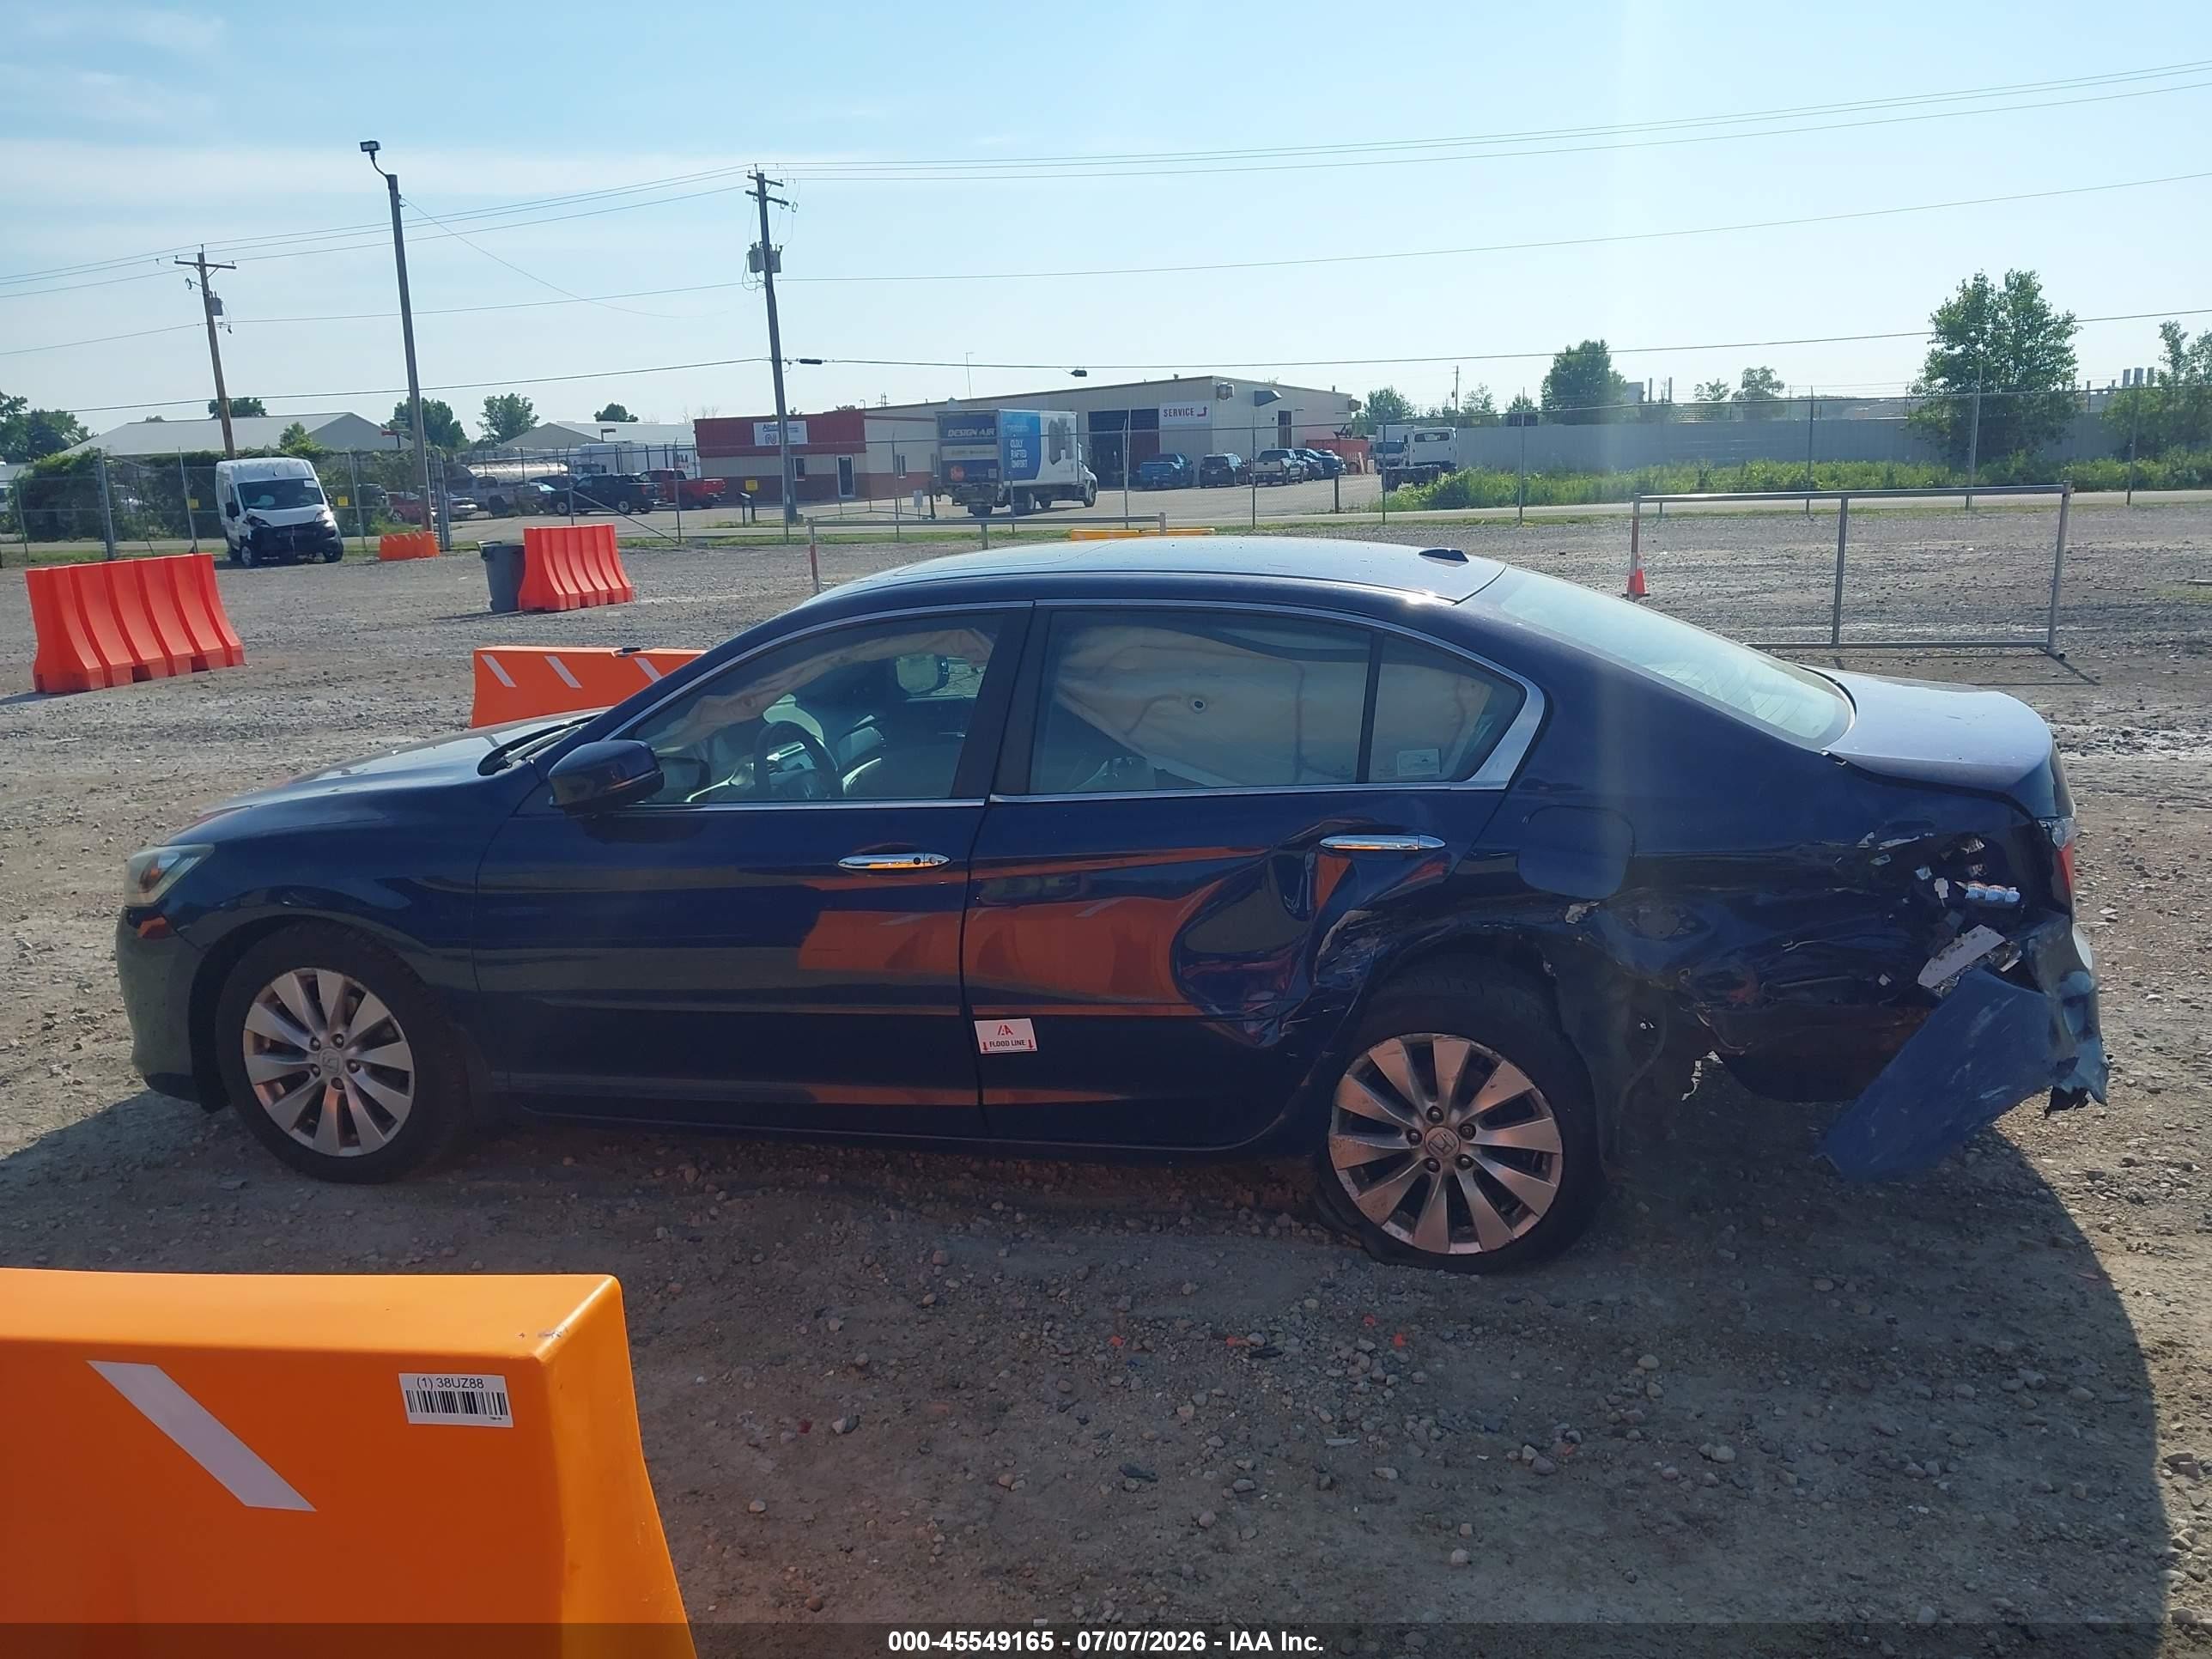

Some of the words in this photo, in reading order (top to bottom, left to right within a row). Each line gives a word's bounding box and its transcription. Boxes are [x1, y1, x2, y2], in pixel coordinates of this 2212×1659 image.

[948, 428, 977, 437] DESIGN
[978, 428, 996, 436] AIR
[1163, 1266, 1194, 1276] SERVICE
[416, 1376, 434, 1390] (1)
[435, 1377, 484, 1389] 38UZ88
